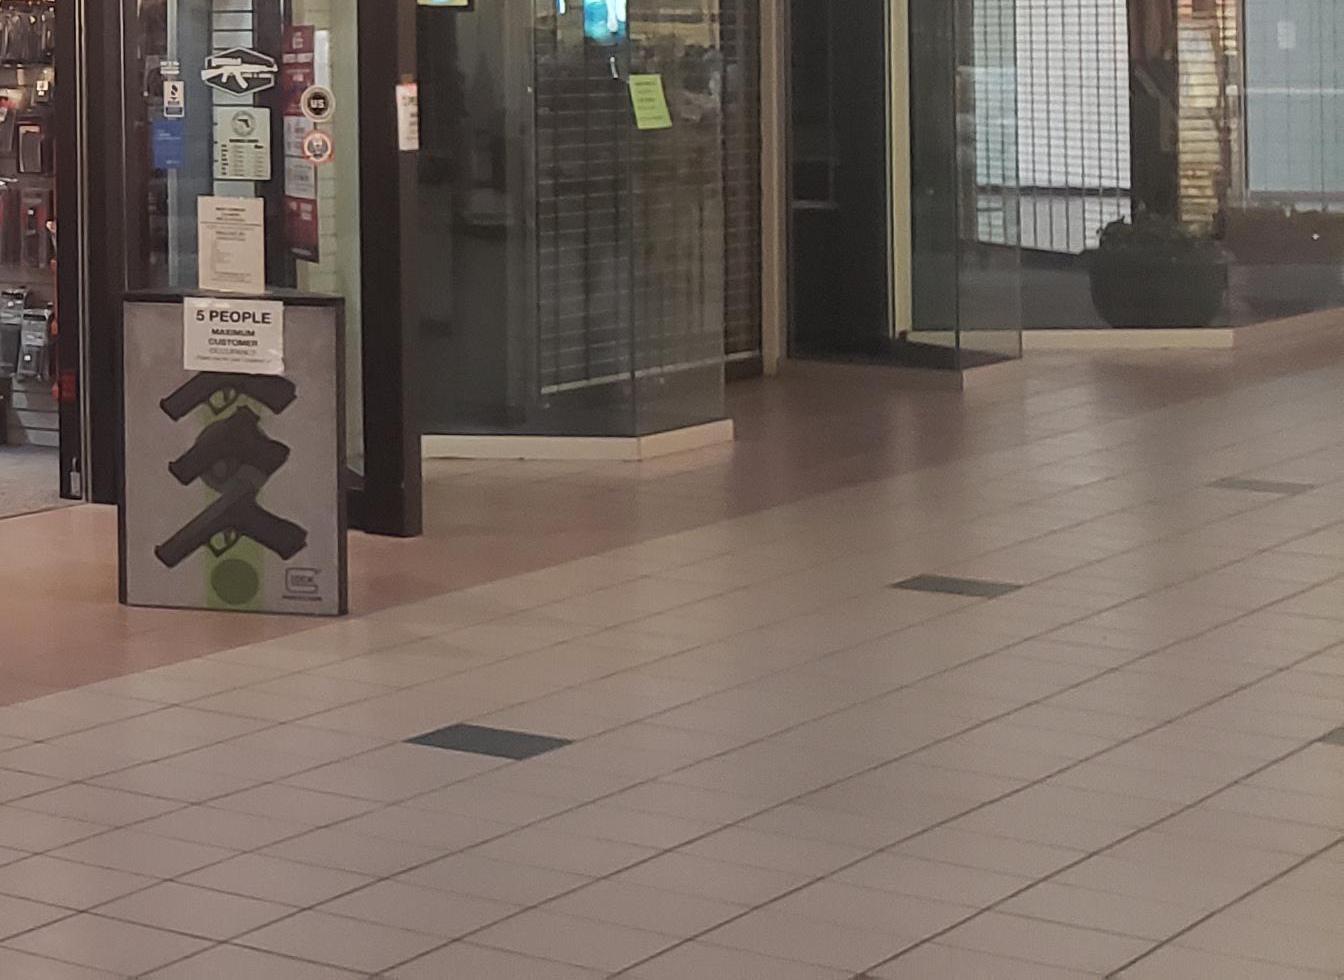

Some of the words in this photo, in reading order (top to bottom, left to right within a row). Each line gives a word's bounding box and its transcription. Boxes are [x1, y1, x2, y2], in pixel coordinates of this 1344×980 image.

[196, 309, 205, 322] 5
[209, 310, 272, 324] PEOPLE
[211, 328, 256, 337] MAXIMUM
[208, 338, 259, 347] CUSTOMER
